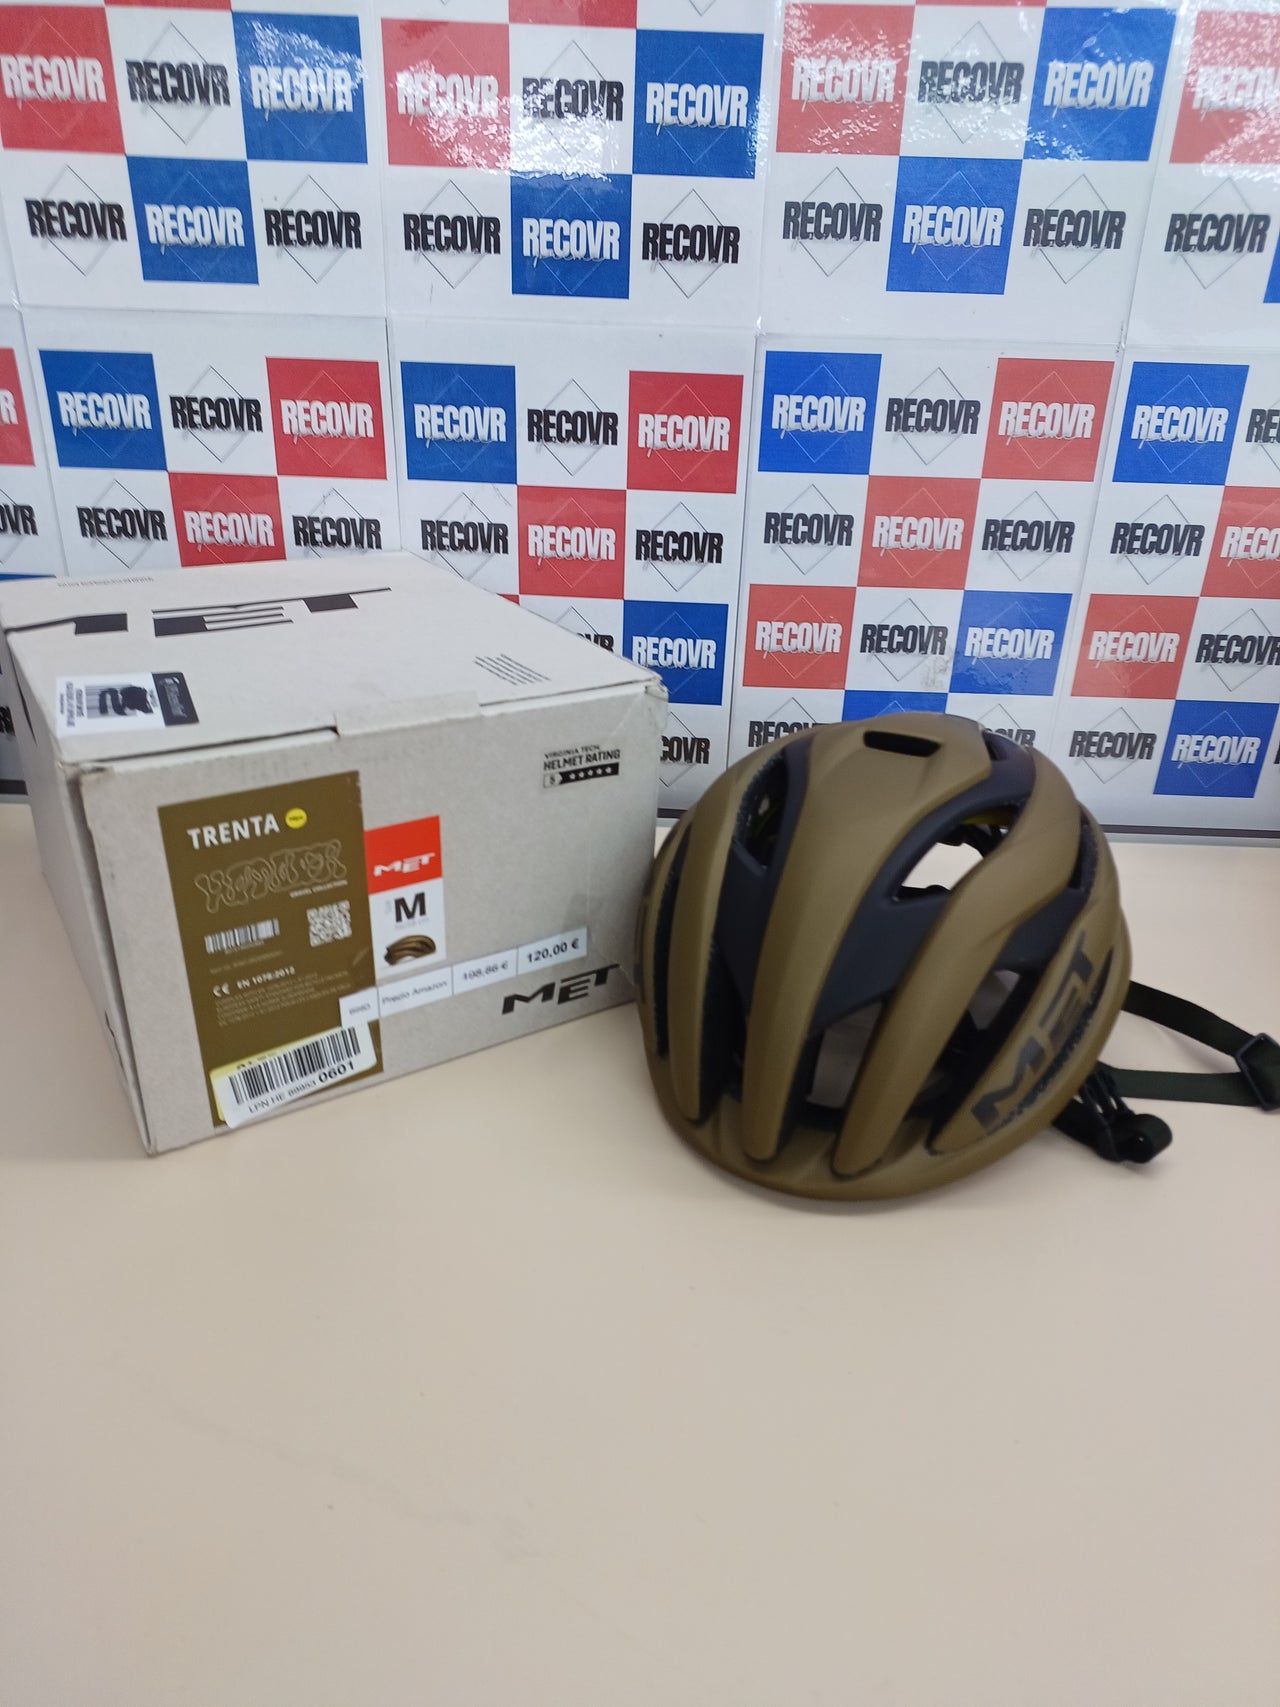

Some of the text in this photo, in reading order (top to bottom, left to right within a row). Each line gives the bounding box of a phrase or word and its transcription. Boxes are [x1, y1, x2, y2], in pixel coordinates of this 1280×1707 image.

[2, 55, 106, 102] RECOVR
[126, 59, 230, 106] RECOVR
[251, 66, 353, 113] RECOVR
[397, 71, 499, 117] RECOVR
[792, 56, 897, 102] RECOVR
[919, 60, 1024, 104] RECOVR
[1045, 61, 1154, 108] RECOVR
[522, 77, 624, 122] RECOVR
[646, 82, 748, 127] RECOVR
[25, 199, 127, 242] RECOVR
[146, 204, 244, 248] RECOVR
[265, 208, 361, 250] RECOVR
[403, 214, 500, 255] RECOVR
[523, 218, 619, 260] RECOVR
[783, 201, 882, 242] RECOVR
[903, 205, 1004, 248] RECOVR
[1024, 208, 1126, 251] RECOVR
[1164, 213, 1271, 253] RECOVR
[642, 222, 740, 263] RECOVR
[57, 391, 151, 431] RECOVR
[169, 395, 262, 433] RECOVR
[281, 400, 373, 439] RECOVR
[415, 404, 506, 443] RECOVR
[527, 408, 618, 447] RECOVR
[772, 393, 866, 433] RECOVR
[886, 397, 980, 436] RECOVR
[999, 401, 1095, 440] RECOVR
[1131, 405, 1229, 444] RECOVR
[638, 414, 730, 453] RECOVR
[77, 506, 168, 541] RECOVR
[184, 510, 274, 547] RECOVR
[293, 515, 382, 550] RECOVR
[421, 520, 509, 555] RECOVR
[528, 525, 616, 561] RECOVR
[764, 511, 854, 547] RECOVR
[873, 515, 964, 552] RECOVR
[982, 518, 1075, 554] RECOVR
[1110, 522, 1205, 557] RECOVR
[635, 530, 723, 564] RECOVR
[632, 636, 716, 669] RECOVR
[756, 620, 842, 655] RECOVR
[861, 623, 948, 656] RECOVR
[965, 626, 1054, 662] RECOVR
[1089, 630, 1180, 665] RECOVR
[544, 749, 621, 771] HELMET RATING
[1069, 731, 1157, 762] RECOVR
[1172, 734, 1261, 766] RECOVR
[187, 813, 280, 850] TRENTA
[374, 852, 436, 877] MET
[394, 891, 427, 923] M
[571, 938, 580, 950] €
[502, 964, 620, 1014] MET
[318, 1061, 355, 1083] 0601
